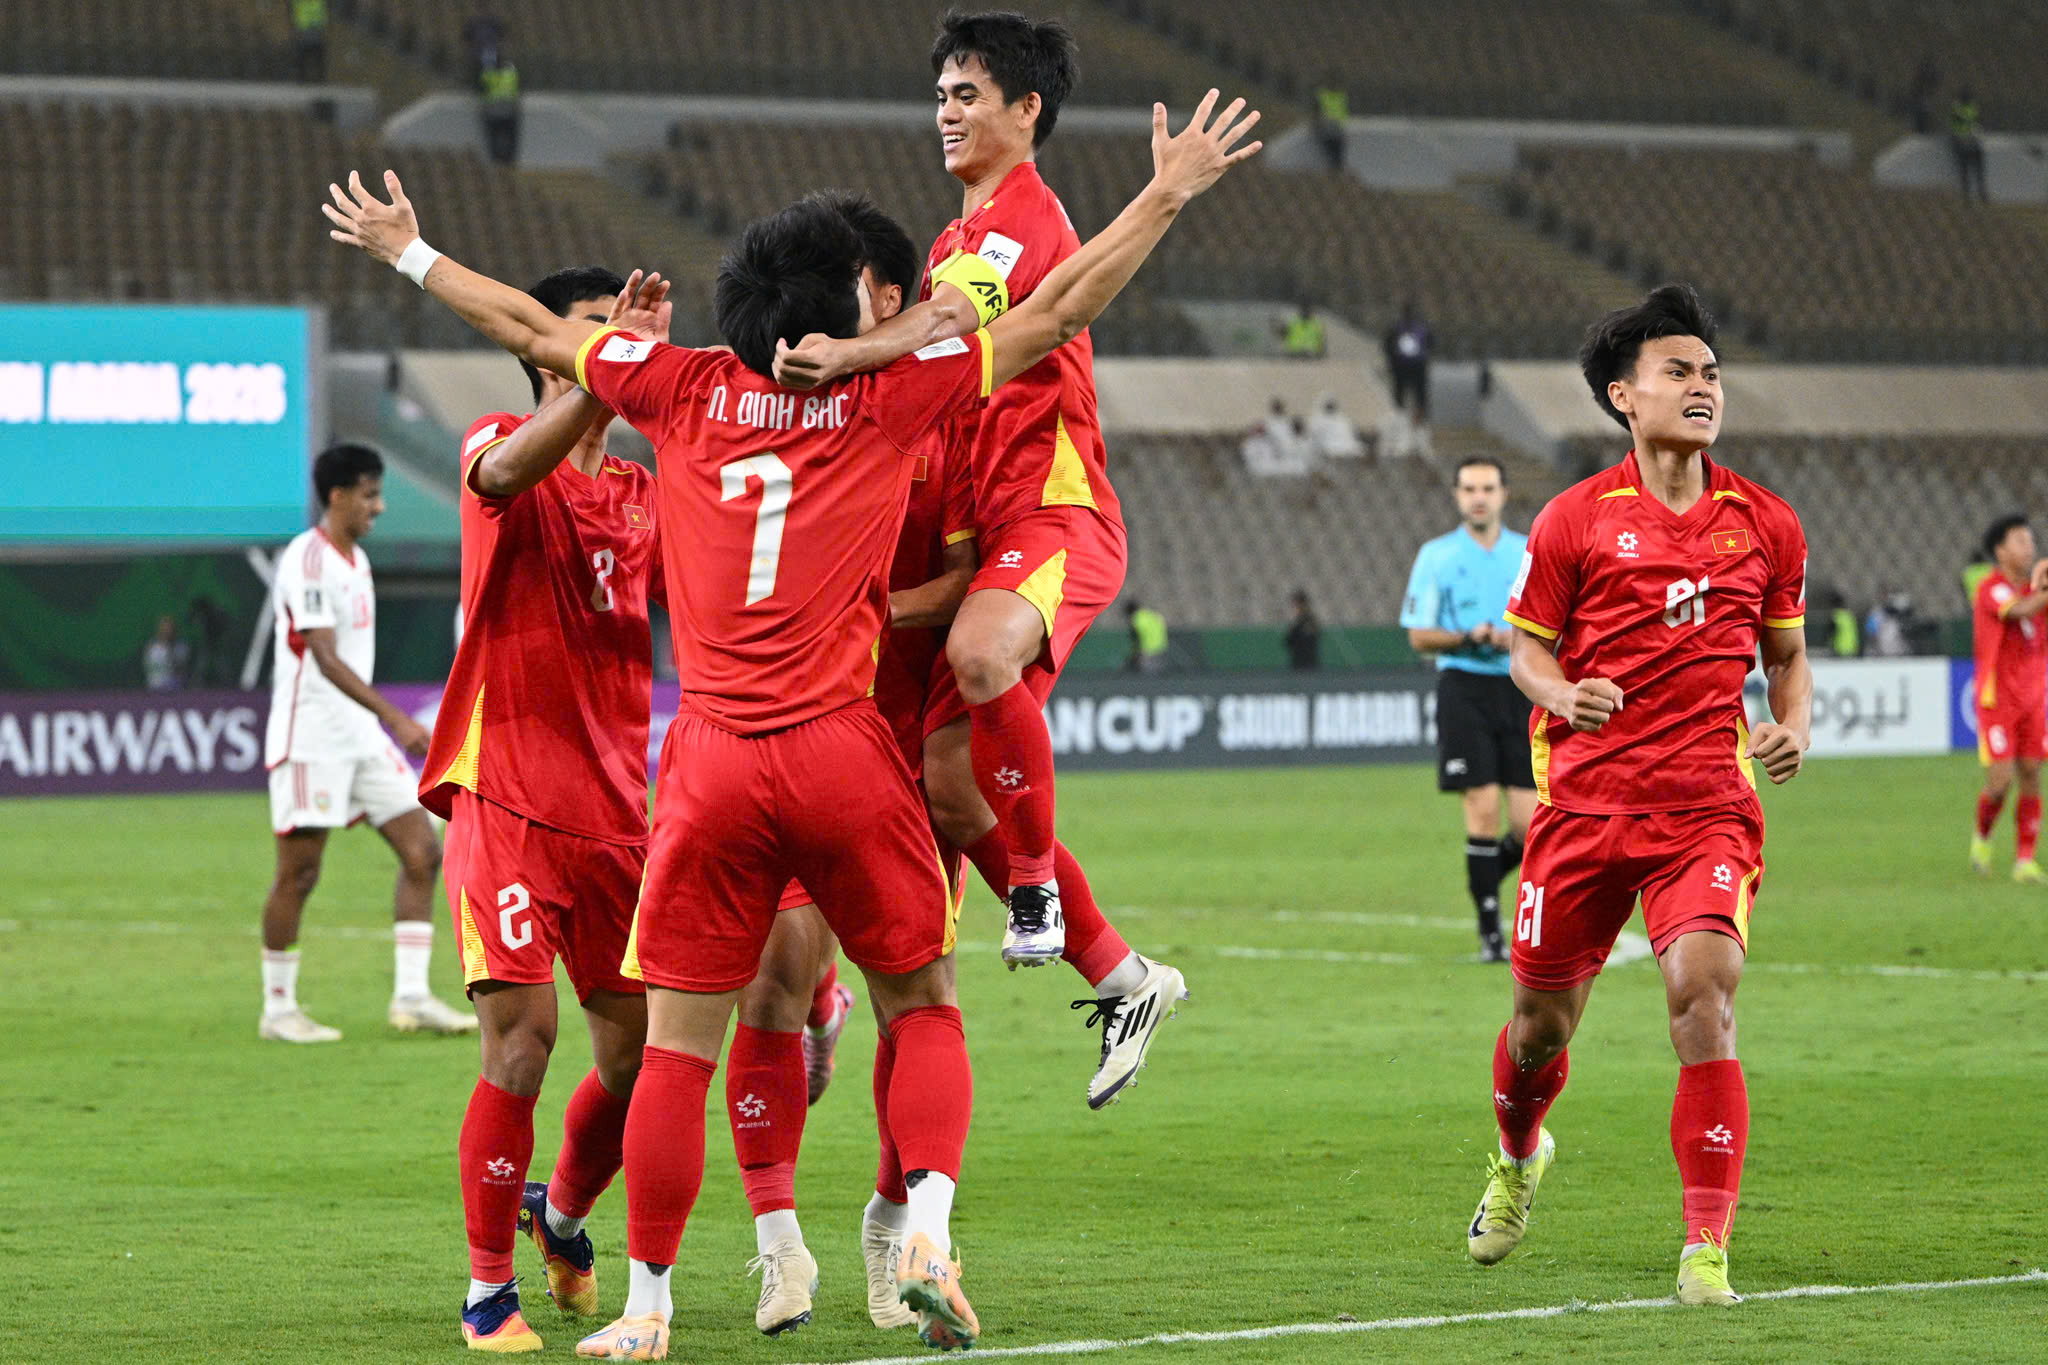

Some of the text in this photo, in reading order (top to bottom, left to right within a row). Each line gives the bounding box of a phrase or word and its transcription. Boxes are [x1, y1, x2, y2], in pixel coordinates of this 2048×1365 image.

[983, 249, 1012, 266] AFC
[720, 450, 793, 607] 7
[590, 547, 616, 612] 2
[0, 706, 260, 777] AIRWAYS
[1097, 695, 1204, 752] CUP
[497, 882, 533, 951] 2
[1517, 881, 1544, 948] 21
